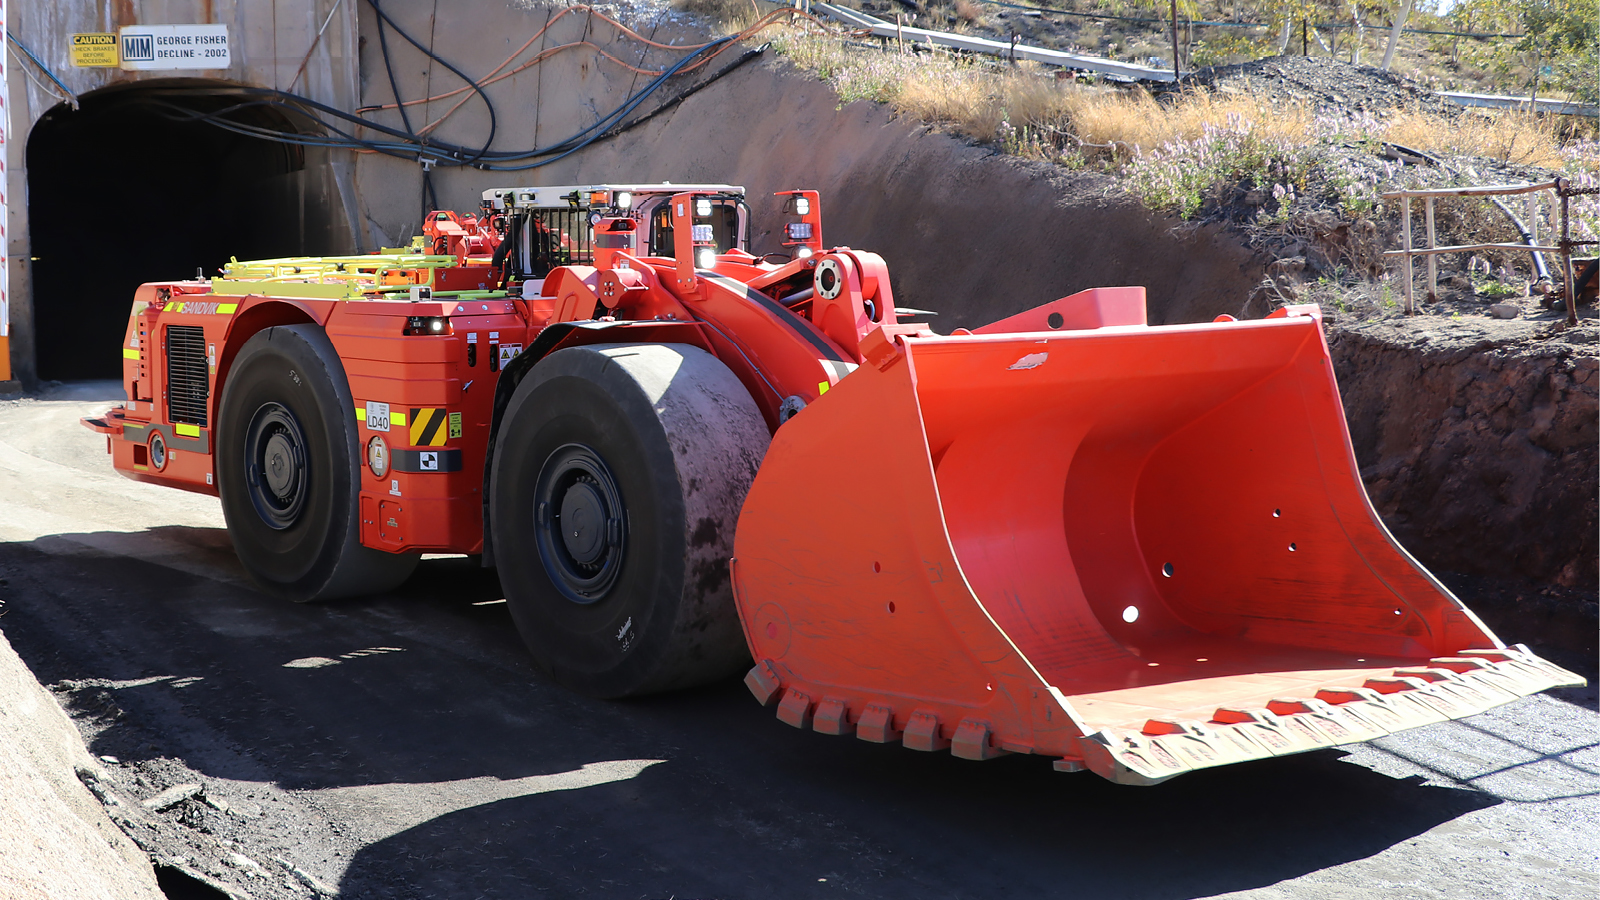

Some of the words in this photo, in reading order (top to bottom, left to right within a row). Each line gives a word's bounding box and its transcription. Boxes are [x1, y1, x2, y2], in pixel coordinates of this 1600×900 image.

[73, 36, 114, 44] CAUTION
[157, 36, 192, 45] GEORGE
[195, 35, 227, 44] FISHER
[124, 38, 151, 58] MIM
[157, 49, 195, 58] DECLINE
[205, 48, 227, 57] 2002
[181, 301, 220, 315] SANDVIK
[368, 415, 388, 430] LD40
